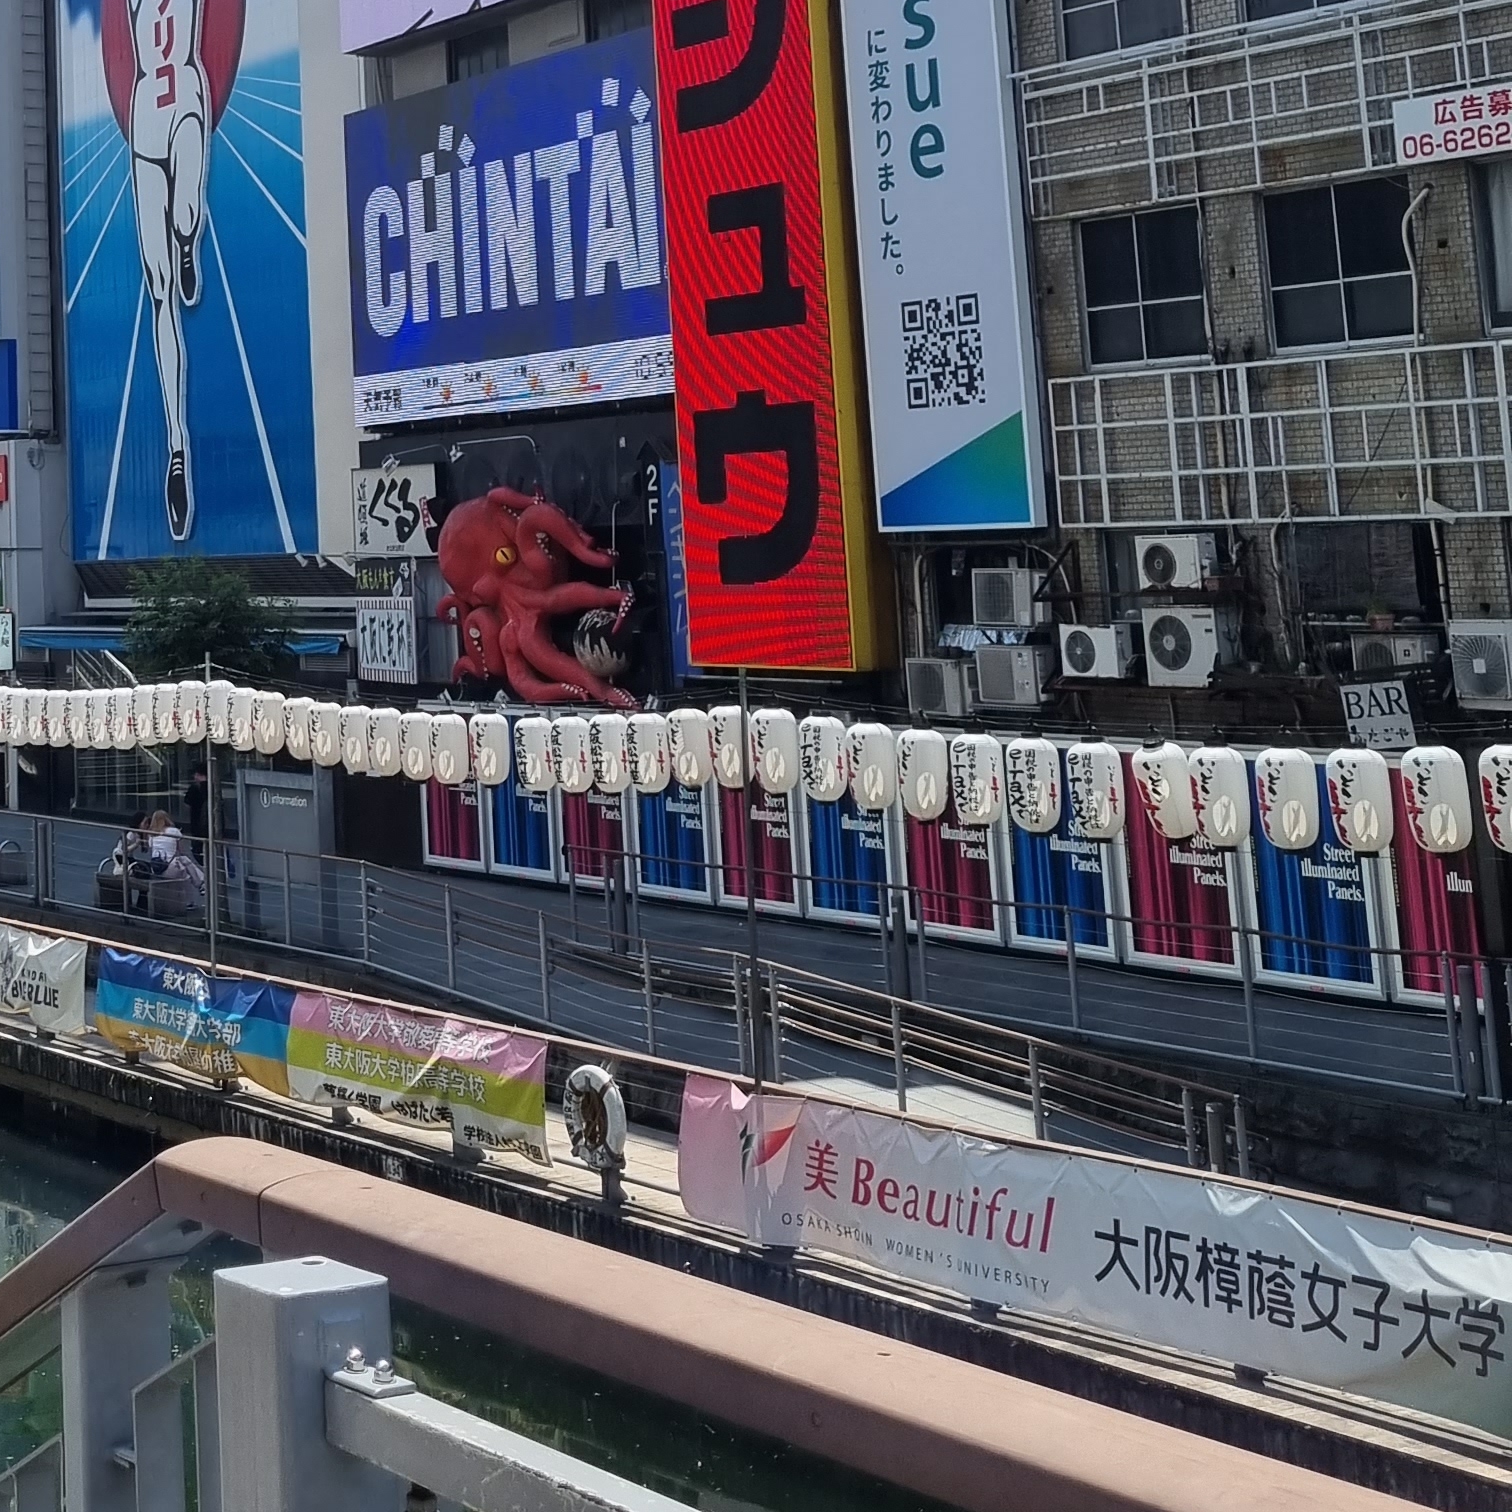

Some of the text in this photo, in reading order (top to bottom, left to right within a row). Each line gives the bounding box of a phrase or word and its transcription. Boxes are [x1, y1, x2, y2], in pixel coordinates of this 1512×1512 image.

[867, 29, 904, 276] に変わりました。
[1403, 121, 1511, 159] 06-6262
[363, 77, 661, 337] CHINTAI
[369, 478, 420, 543] くくる
[646, 464, 659, 525] 2F
[1344, 687, 1409, 719] BAR
[271, 794, 308, 808] information
[961, 844, 988, 860] Panels.
[1072, 855, 1101, 874] Panels.
[1324, 843, 1356, 864] Street
[1193, 867, 1228, 888] Panels.
[1327, 882, 1365, 903] Panels.
[803, 1139, 1056, 1254] 美 Beautiful
[782, 1212, 832, 1233] OSAKA
[836, 1223, 874, 1247] SHOIN
[957, 1257, 1051, 1294] UNIVERSITY
[1092, 1218, 1506, 1379] 大阪樟蔭女子大学
